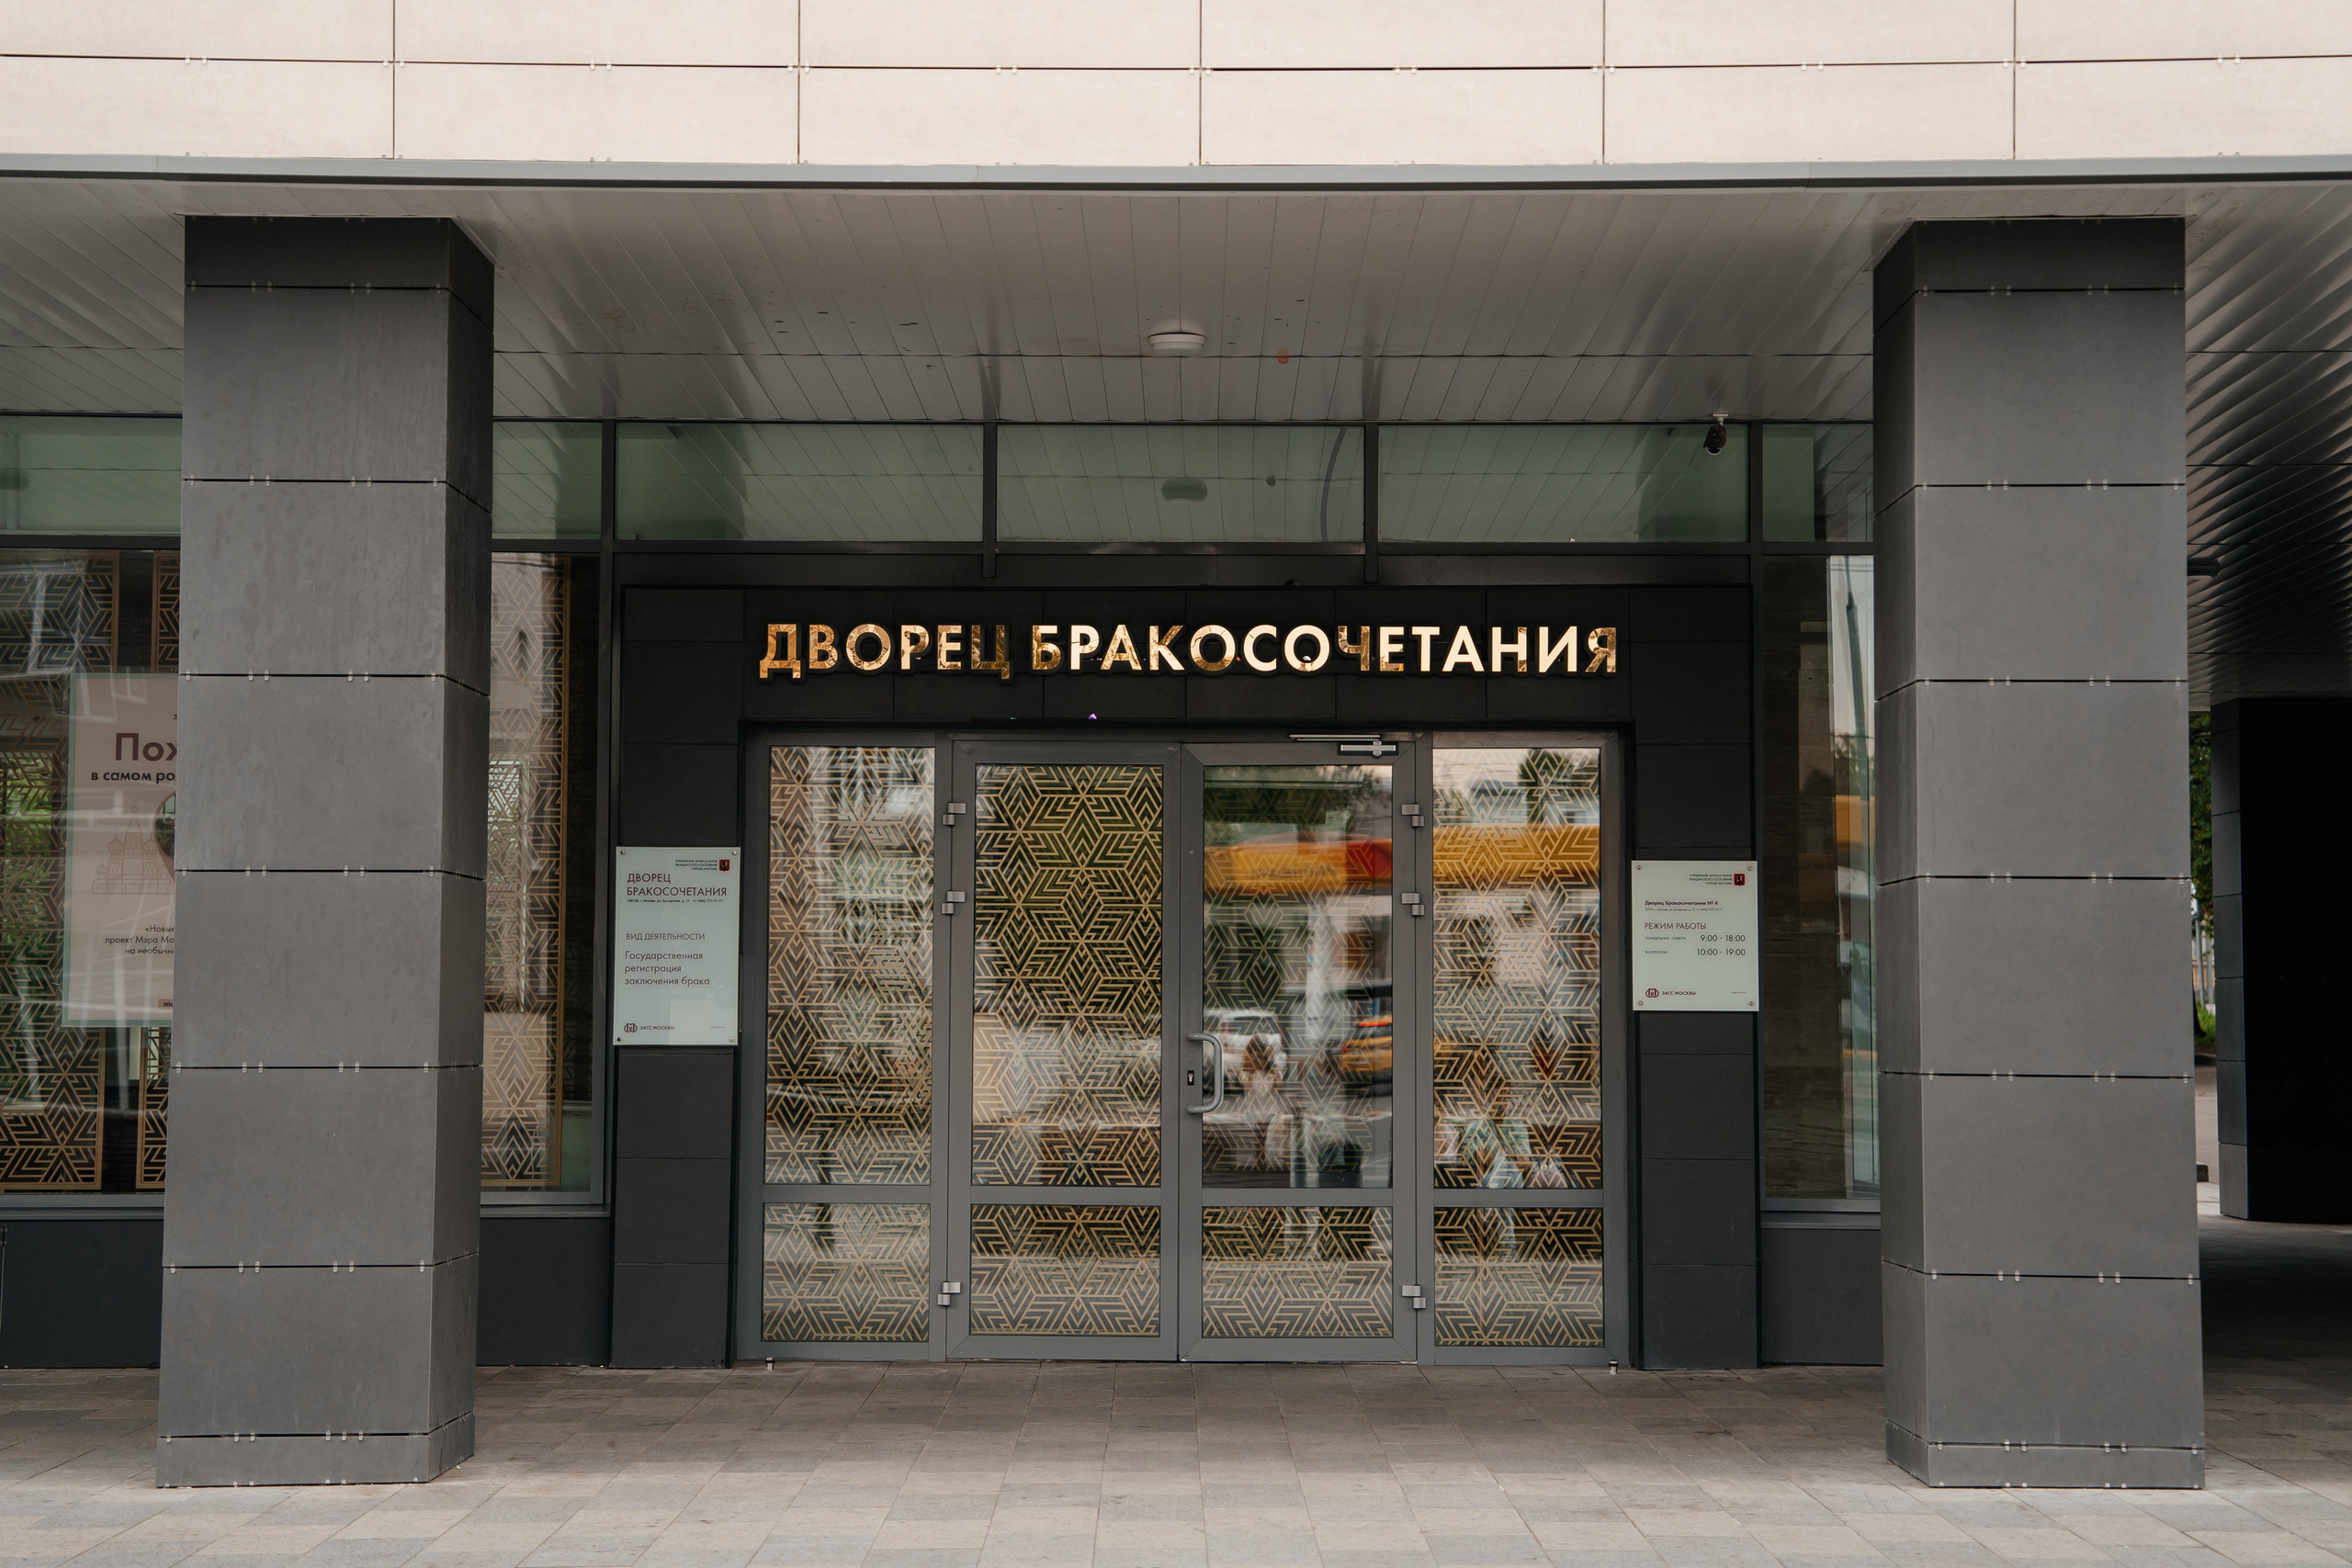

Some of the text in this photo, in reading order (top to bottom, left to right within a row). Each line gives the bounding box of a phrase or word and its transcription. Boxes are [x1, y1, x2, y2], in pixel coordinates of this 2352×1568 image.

[759, 623, 1617, 680] ДВОРЕЦ БРАКОСОЧЕТАНИЯ
[91, 772, 99, 781] в
[103, 772, 152, 781] самом
[627, 873, 671, 884] ДВОРЕЦ
[627, 887, 727, 896] БРАКОСОЧЕТАНИЯ
[135, 936, 158, 945] Мэра
[625, 951, 703, 962] Государственная
[625, 966, 682, 974] регистрация
[681, 976, 710, 987] брака
